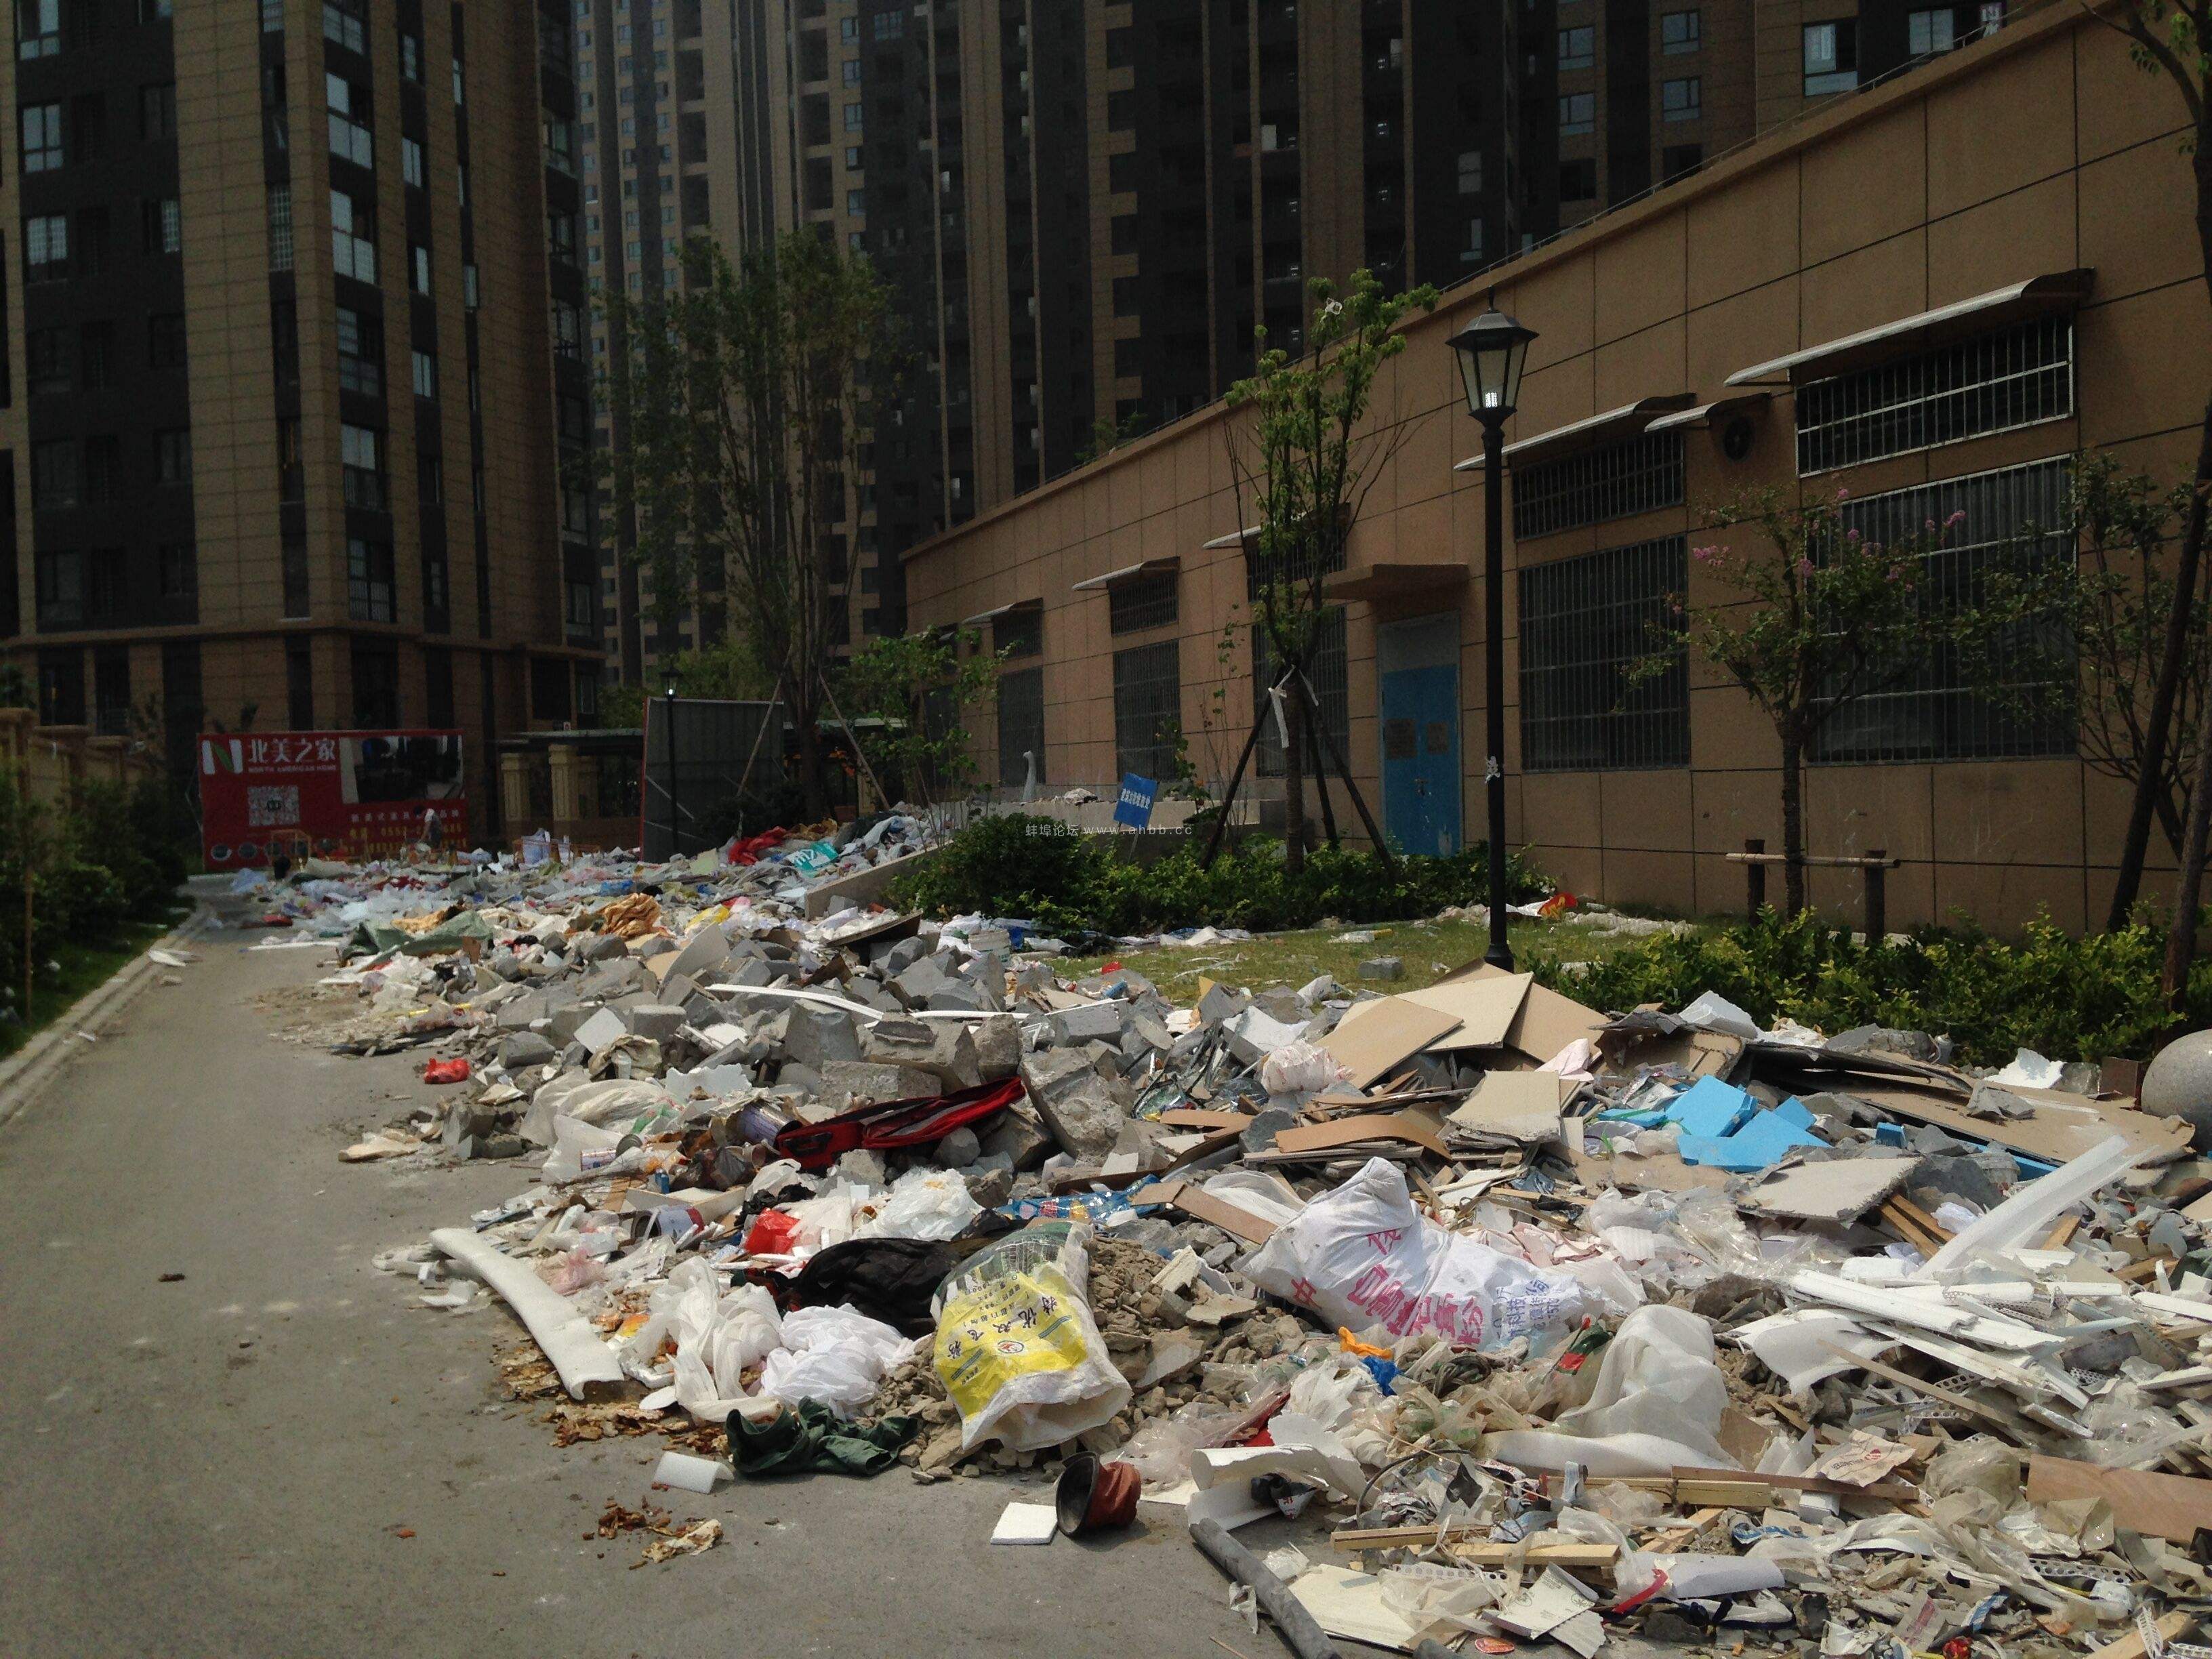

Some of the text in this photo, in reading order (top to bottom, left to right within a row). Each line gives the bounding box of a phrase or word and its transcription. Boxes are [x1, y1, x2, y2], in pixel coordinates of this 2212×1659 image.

[248, 737, 336, 764] 北美之家
[949, 1296, 1058, 1359] 特优双飞粉
